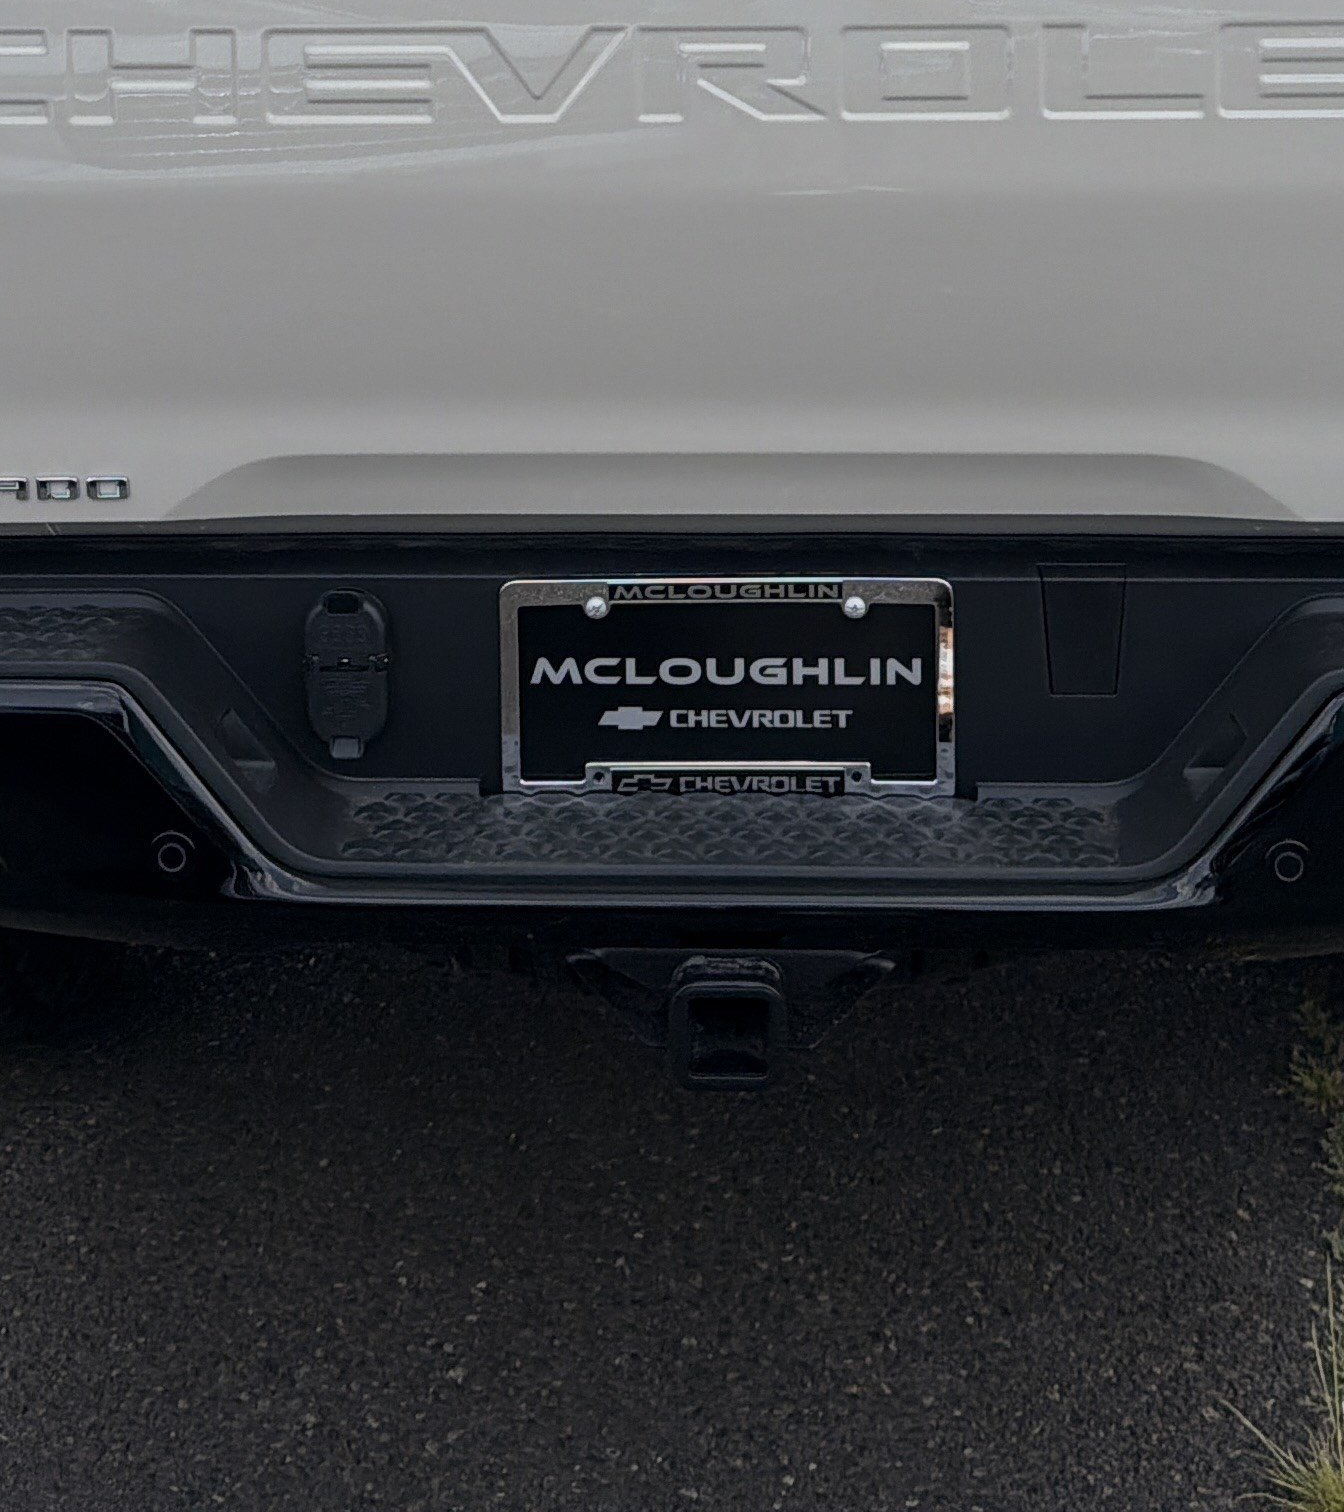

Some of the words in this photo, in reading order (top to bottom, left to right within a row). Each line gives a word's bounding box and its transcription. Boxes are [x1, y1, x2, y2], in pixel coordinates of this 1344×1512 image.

[613, 584, 840, 601] MCLOUGHLIN
[530, 656, 923, 687] MCLOUGHLIN
[669, 709, 854, 730] CHEVROLET
[678, 776, 842, 795] CHEVROLET
